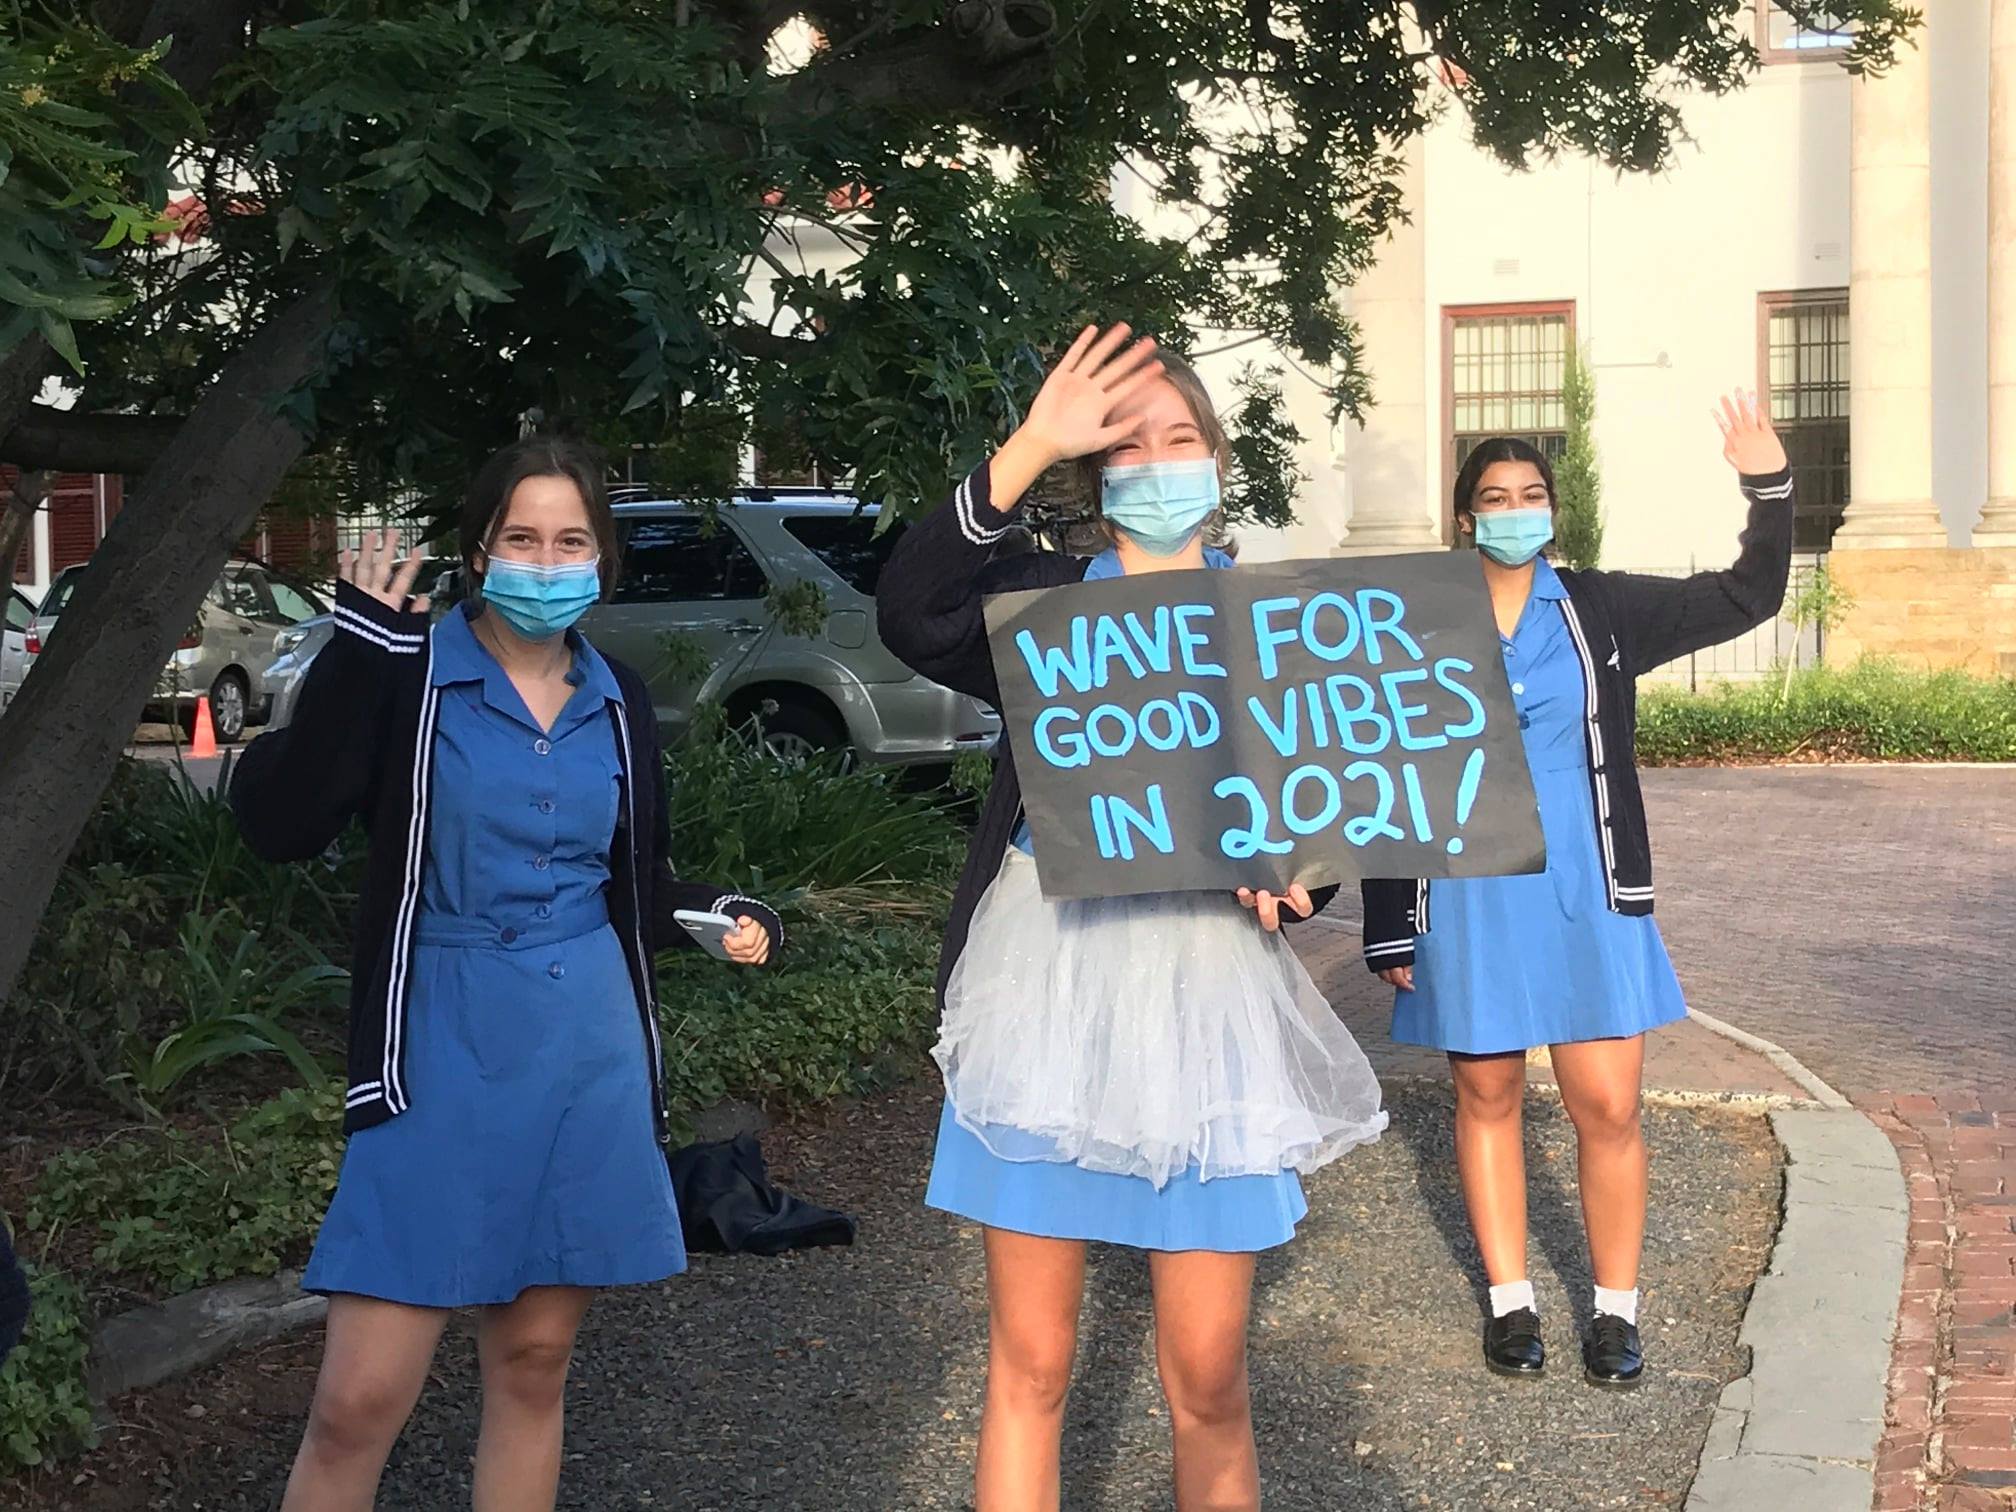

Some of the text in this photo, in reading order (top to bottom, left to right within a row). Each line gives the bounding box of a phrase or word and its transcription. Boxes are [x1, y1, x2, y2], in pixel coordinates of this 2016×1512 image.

[1016, 588, 1424, 698] WAVE FOR
[1034, 657, 1487, 768] GOOD VIBES
[1091, 748, 1485, 860] IN 2021!
